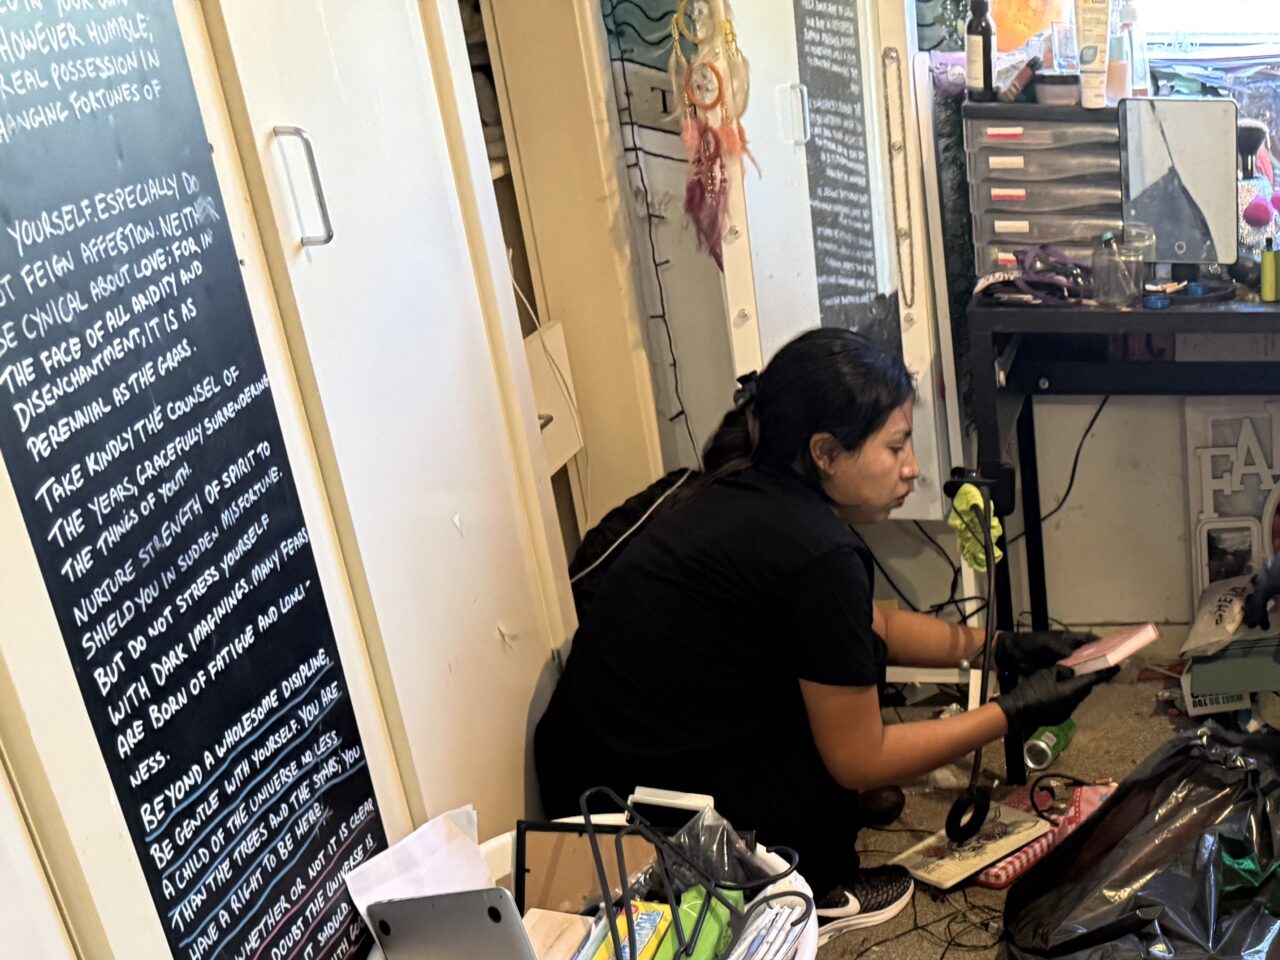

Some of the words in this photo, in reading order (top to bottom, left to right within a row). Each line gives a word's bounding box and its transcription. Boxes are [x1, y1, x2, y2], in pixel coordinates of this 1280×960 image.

[0, 21, 85, 63] HOWEVER
[86, 12, 154, 46] HUMBLE;
[51, 51, 138, 90] POSSESSION
[139, 48, 160, 70] IN
[69, 83, 140, 120] FORTUNES
[144, 79, 161, 100] OF
[95, 173, 180, 220] ESPECIALLY
[182, 171, 199, 195] DO
[20, 250, 75, 295] FEIGN
[22, 290, 88, 339] CYNICAL
[89, 263, 130, 303] ABOUT
[172, 236, 201, 264] FOR
[143, 317, 160, 344] IT
[163, 308, 180, 332] IS
[181, 297, 198, 321] AS
[0, 357, 36, 394] THE
[40, 336, 82, 375] FACE
[85, 320, 105, 349] OF
[105, 304, 131, 333] ALL
[131, 273, 179, 314] ARIDITY
[180, 260, 203, 286] AND
[26, 397, 112, 462] PERENNIAL
[112, 383, 131, 408] AS
[128, 361, 157, 394] THE
[34, 463, 85, 513] TAKE
[85, 427, 135, 478] KINDLY
[133, 406, 165, 444] THE
[166, 375, 221, 421] COUNSEL
[223, 366, 241, 388] OF
[48, 508, 86, 548] THE
[88, 476, 138, 526] YEARS,
[136, 422, 203, 487] GRACEFULLY
[205, 373, 271, 436] SURRENDERING
[61, 545, 94, 583] THE
[140, 493, 157, 517] OF
[73, 558, 136, 628] NURTURE
[138, 493, 204, 570] STRENGTH
[204, 480, 222, 506] OF
[222, 448, 256, 490] SPIRIT
[255, 440, 272, 461] TO
[80, 600, 136, 661] SHIELD
[134, 583, 160, 614] YOU
[162, 567, 178, 590] IN
[178, 525, 220, 573] SUDDEN
[93, 651, 127, 697] BUT
[127, 635, 147, 660] DO
[148, 604, 174, 639] NOT
[176, 565, 220, 615] STRESS
[220, 513, 271, 578] YOURSELF
[107, 676, 151, 727] WITH
[150, 643, 189, 687] DARK
[251, 554, 281, 587] MANY
[280, 526, 309, 562] FEARS
[116, 719, 146, 760] ARE
[148, 688, 189, 731] BORN
[189, 670, 208, 696] OF
[207, 624, 256, 681] FATIGUE
[257, 605, 280, 633] AND
[129, 753, 171, 788] NESS.
[140, 765, 204, 833] BEYOND
[203, 750, 215, 771] A
[214, 688, 279, 759] WHOLESOME
[149, 838, 175, 871] BE
[174, 788, 220, 846] GENTLE
[224, 761, 251, 796] WITH
[298, 698, 322, 728] YOU
[321, 681, 339, 706] ARE
[162, 878, 175, 900] A
[175, 847, 210, 884] CHILD
[210, 829, 226, 853] OF
[226, 805, 250, 836] THE
[250, 761, 299, 812] UNIVERSE
[300, 750, 314, 764] NO
[315, 730, 339, 755] LESS
[171, 888, 207, 933] THAN
[205, 863, 233, 897] THE
[233, 823, 269, 868] TREES
[270, 805, 290, 830] AND
[291, 781, 312, 809] THE
[342, 745, 361, 769] YOU
[290, 877, 306, 901] OR
[307, 853, 327, 881] NOT
[328, 838, 339, 855] IT
[338, 825, 350, 841] IS
[218, 909, 231, 929] A
[230, 868, 264, 916] RIGHT
[262, 853, 277, 873] TO
[277, 838, 294, 861] BE
[305, 889, 326, 924] THE
[364, 833, 375, 851] IS
